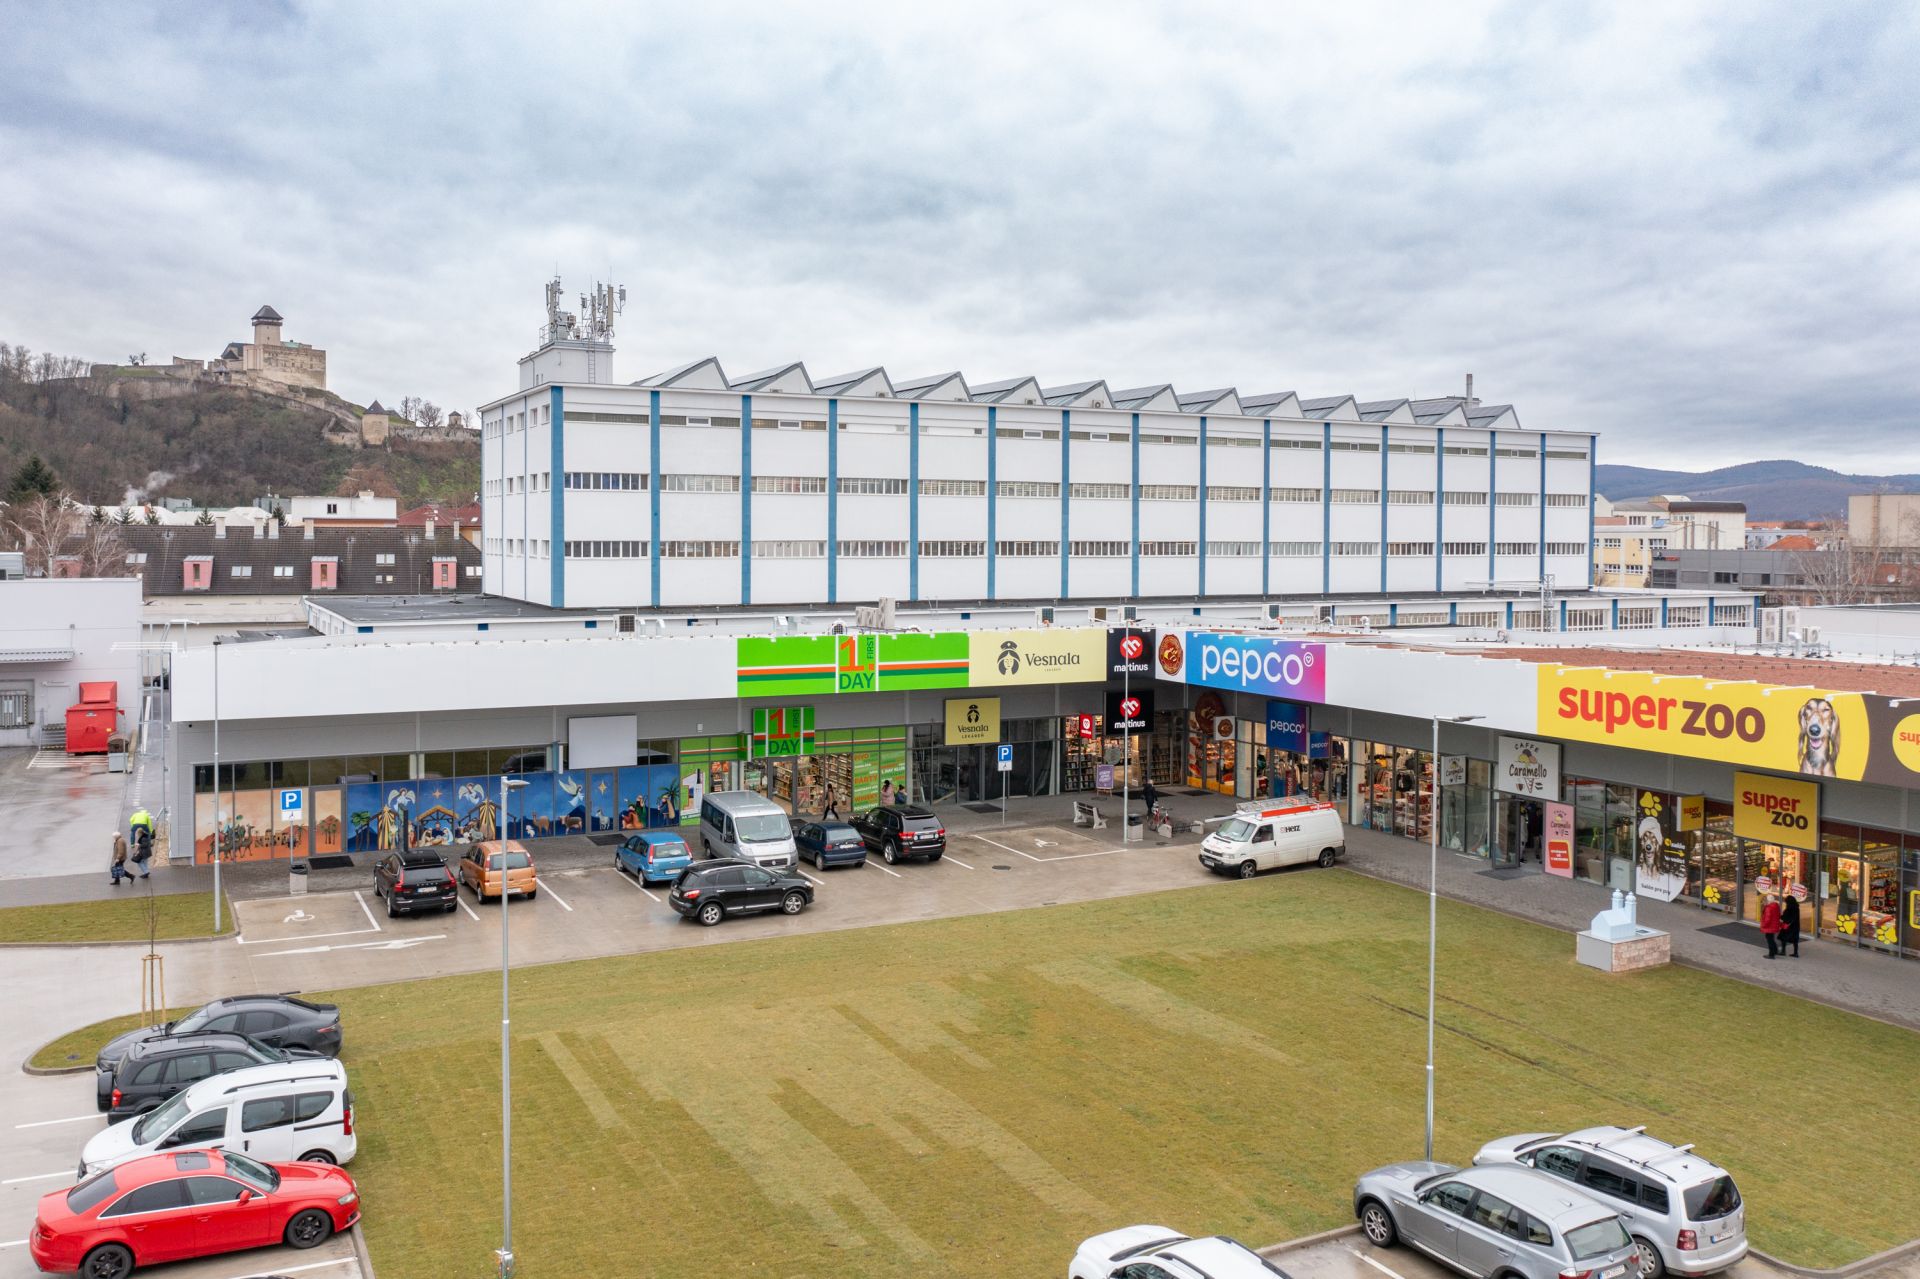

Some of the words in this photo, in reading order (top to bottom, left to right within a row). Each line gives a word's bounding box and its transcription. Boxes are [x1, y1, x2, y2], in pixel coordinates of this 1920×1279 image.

[867, 636, 875, 660] FIRST
[1025, 653, 1081, 667] Vesnala
[1202, 645, 1304, 687] pepco
[839, 672, 874, 690] DAY
[1558, 686, 1677, 734] super
[1680, 700, 1766, 743] zoo
[958, 724, 989, 733] Vesnala
[1114, 720, 1146, 729] matinus
[1270, 719, 1303, 734] pepco
[768, 739, 800, 755] DAY
[1001, 747, 1009, 760] P
[1508, 764, 1548, 779] Caramello
[285, 792, 298, 809] P
[1742, 790, 1801, 813] super
[1771, 811, 1809, 830] zoo
